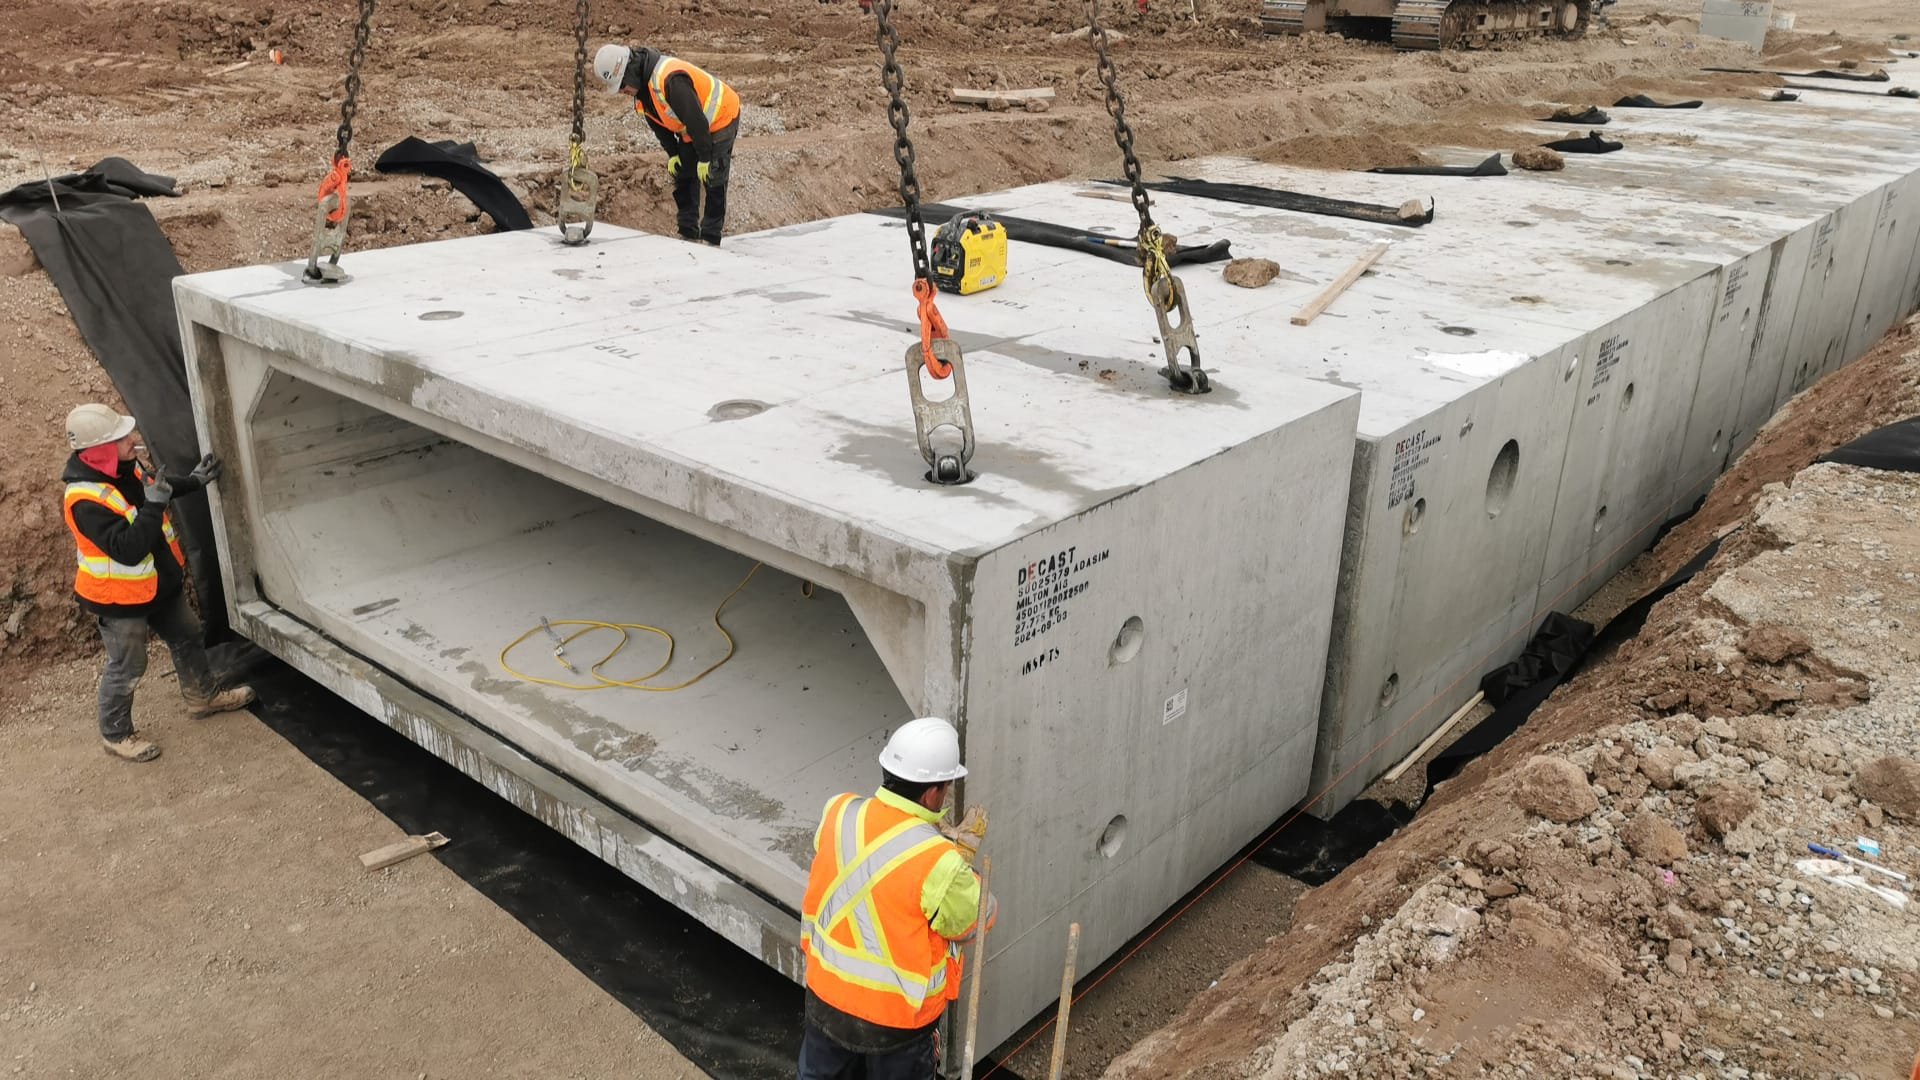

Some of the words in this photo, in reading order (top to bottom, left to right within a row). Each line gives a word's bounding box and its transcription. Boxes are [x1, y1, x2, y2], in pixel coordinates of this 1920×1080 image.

[594, 345, 640, 359] TOP
[1395, 429, 1426, 455] DECAST
[1018, 546, 1076, 586] DECAST
[1073, 549, 1109, 573] ADASIM
[1016, 587, 1049, 611] MILTON
[1022, 653, 1045, 676] INSP
